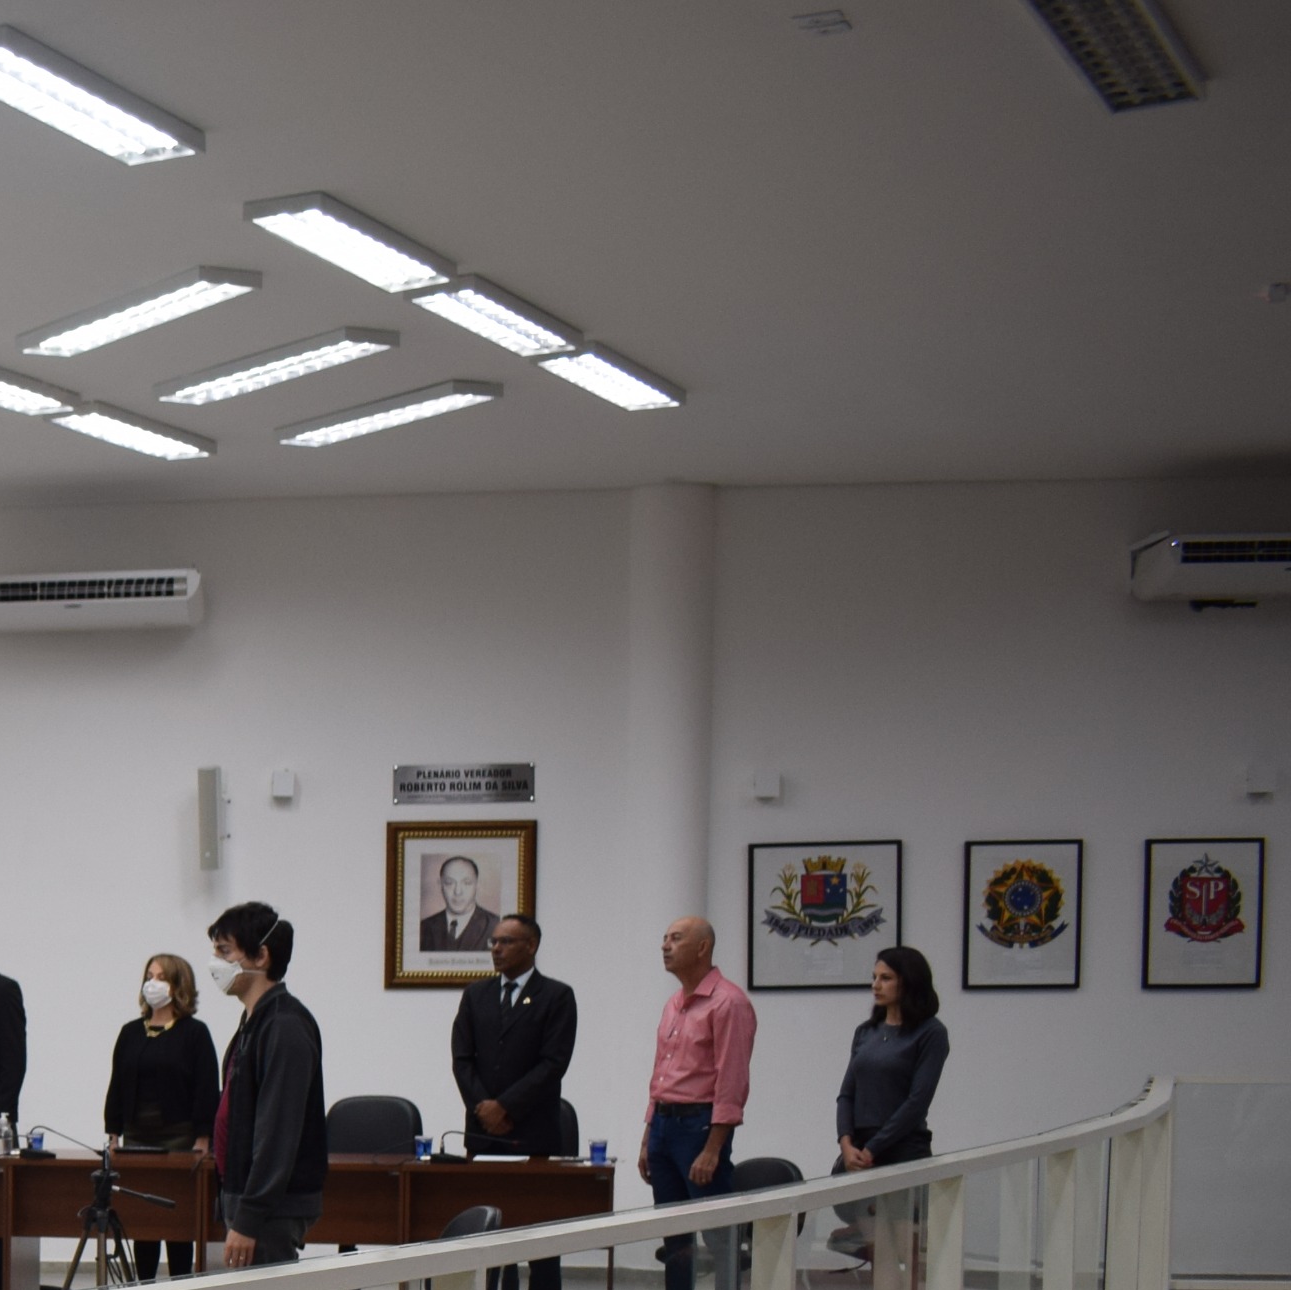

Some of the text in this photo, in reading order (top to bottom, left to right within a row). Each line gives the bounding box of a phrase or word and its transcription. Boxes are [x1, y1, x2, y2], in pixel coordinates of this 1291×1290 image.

[416, 768, 512, 780] PLENÁRIO VEREADOR
[399, 780, 529, 793] ROBERTO ROLIM DA SILVA
[798, 924, 850, 937] PIEDADE
